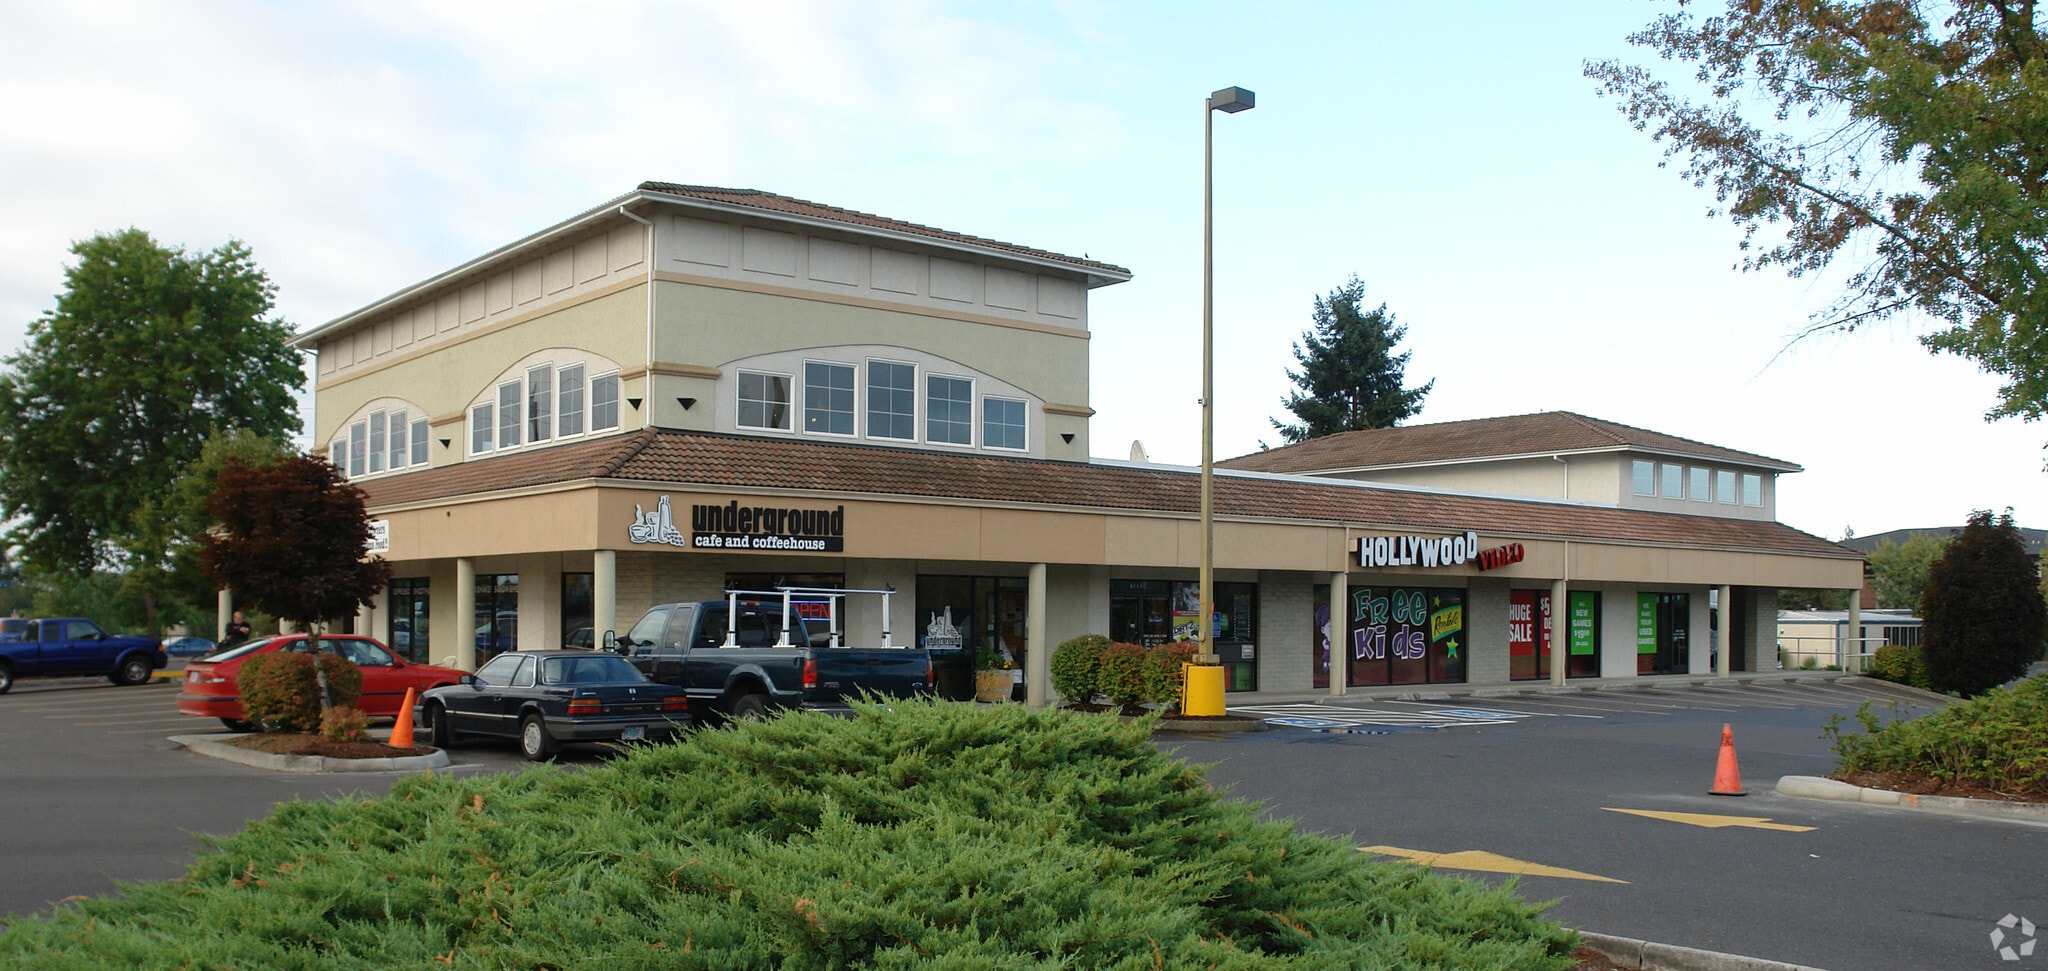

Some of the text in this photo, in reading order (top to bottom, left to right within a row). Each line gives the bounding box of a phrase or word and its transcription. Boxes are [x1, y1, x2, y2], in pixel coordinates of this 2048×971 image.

[692, 500, 844, 536] underground
[695, 534, 826, 550] cafe and coffeehouse
[1359, 531, 1525, 571] HOLLYWOOD VIDEO
[1509, 604, 1531, 621] HUGE
[1541, 597, 1550, 616] $5
[1509, 623, 1532, 642] SALE
[1572, 619, 1592, 627] GAMES
[1354, 624, 1426, 660] Kids
